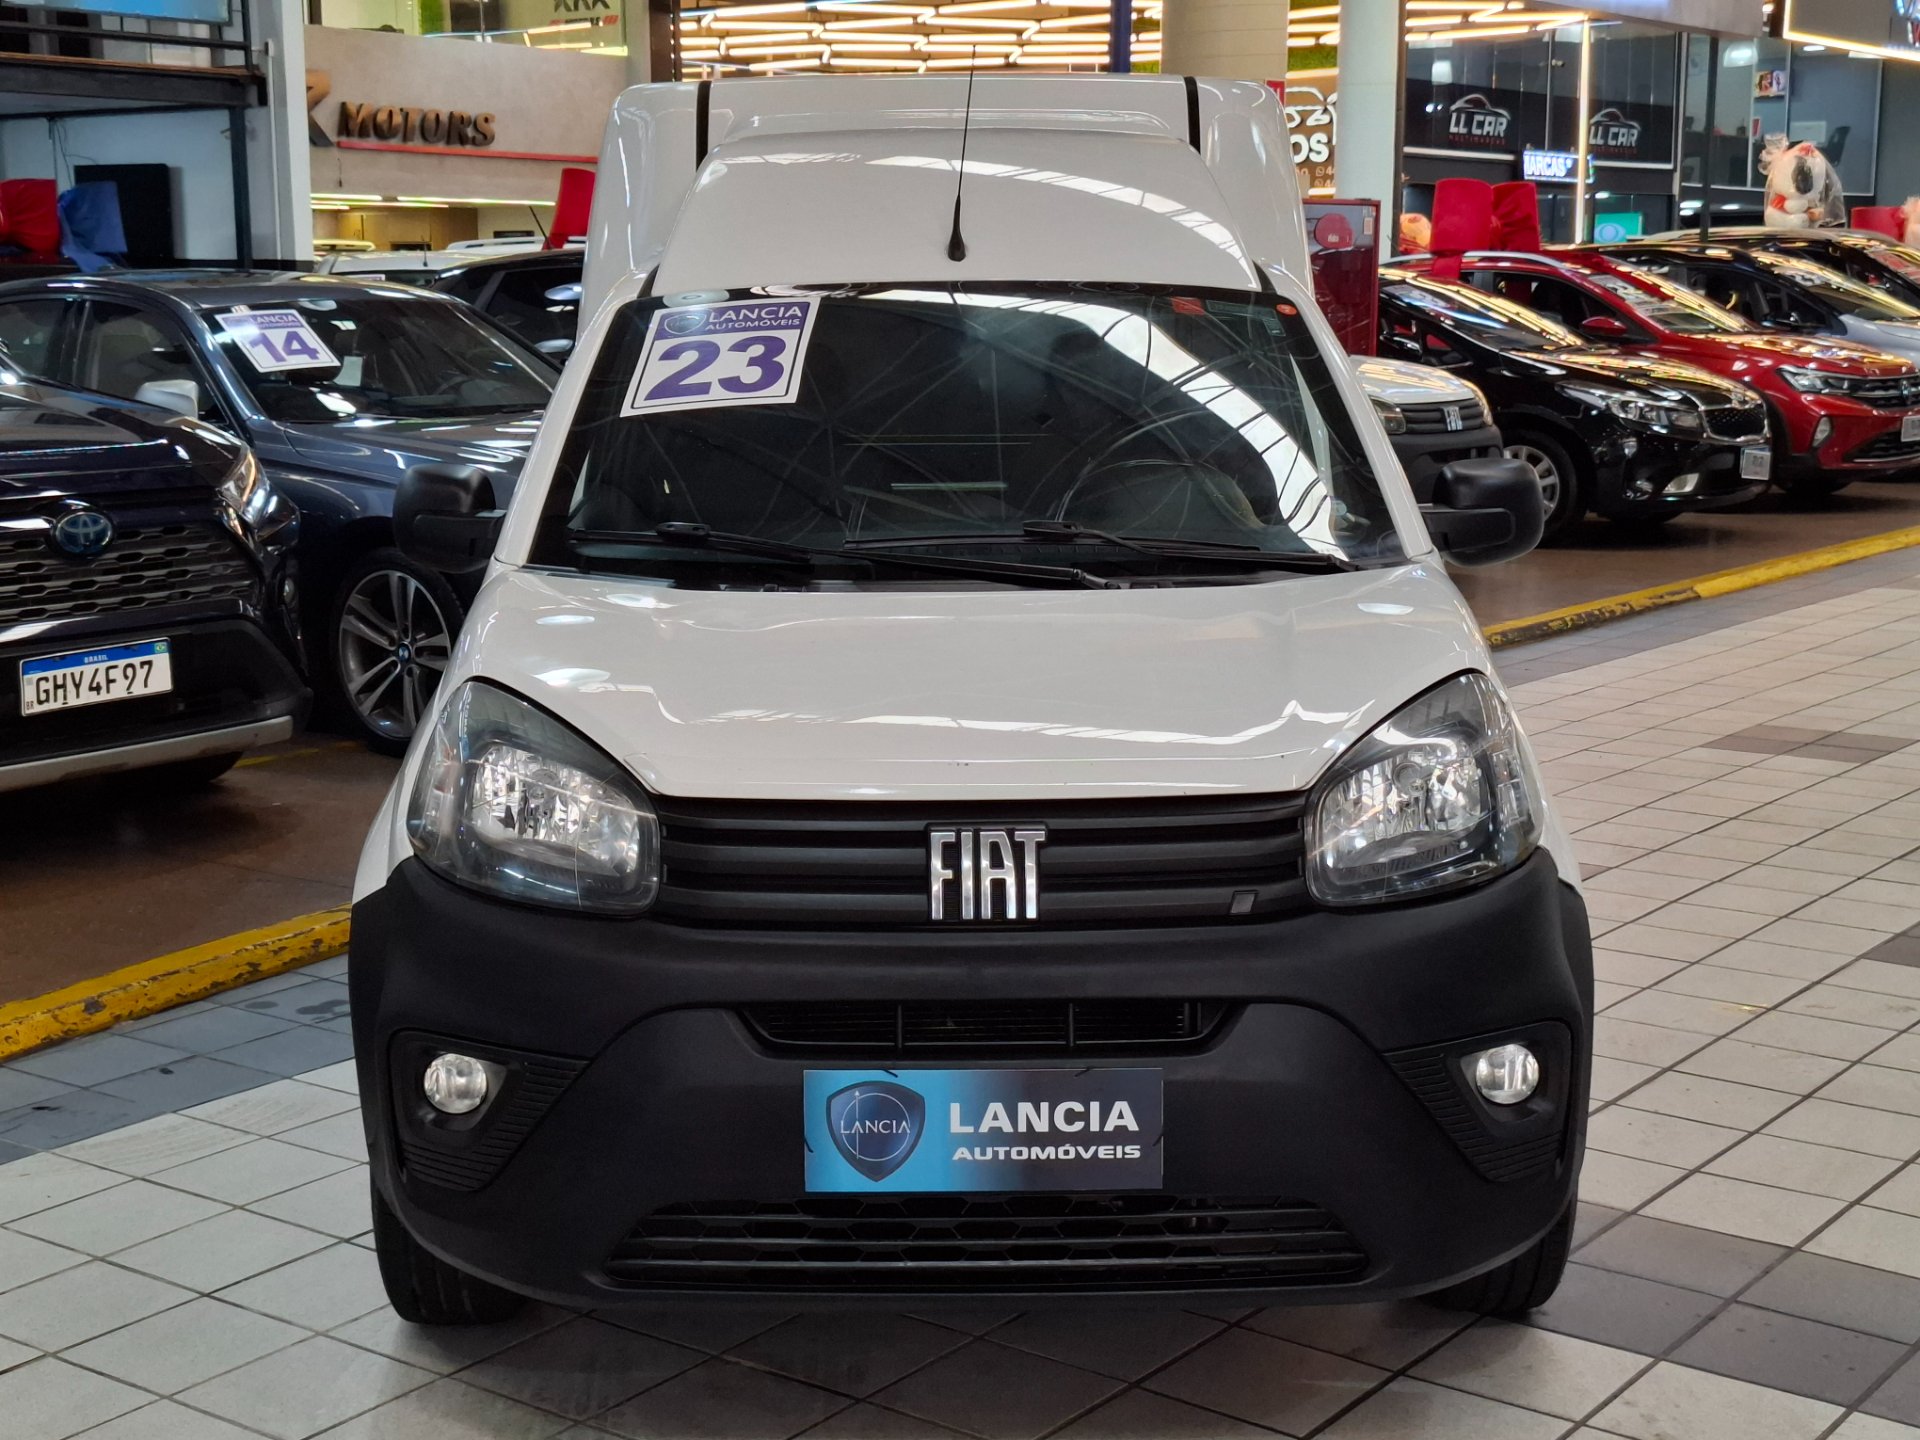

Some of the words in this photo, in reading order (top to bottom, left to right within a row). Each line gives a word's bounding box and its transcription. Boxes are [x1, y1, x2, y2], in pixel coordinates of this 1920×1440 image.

[337, 101, 496, 147] MOTORS
[1449, 112, 1469, 134] LL
[1471, 114, 1508, 138] CAR
[1589, 126, 1605, 145] LL
[1607, 127, 1639, 147] CAR
[704, 318, 801, 331] AUTOMÓVEIS
[708, 306, 803, 323] LANCIA
[248, 330, 320, 363] 14
[643, 335, 787, 401] 23
[84, 655, 109, 664] BRASIL
[36, 660, 153, 706] GHY4F97
[930, 831, 1046, 920] FIAT
[841, 1119, 910, 1134] LANCIA
[950, 1101, 1139, 1133] LANCIA
[952, 1143, 1141, 1161] AUTOMÓVEIS
